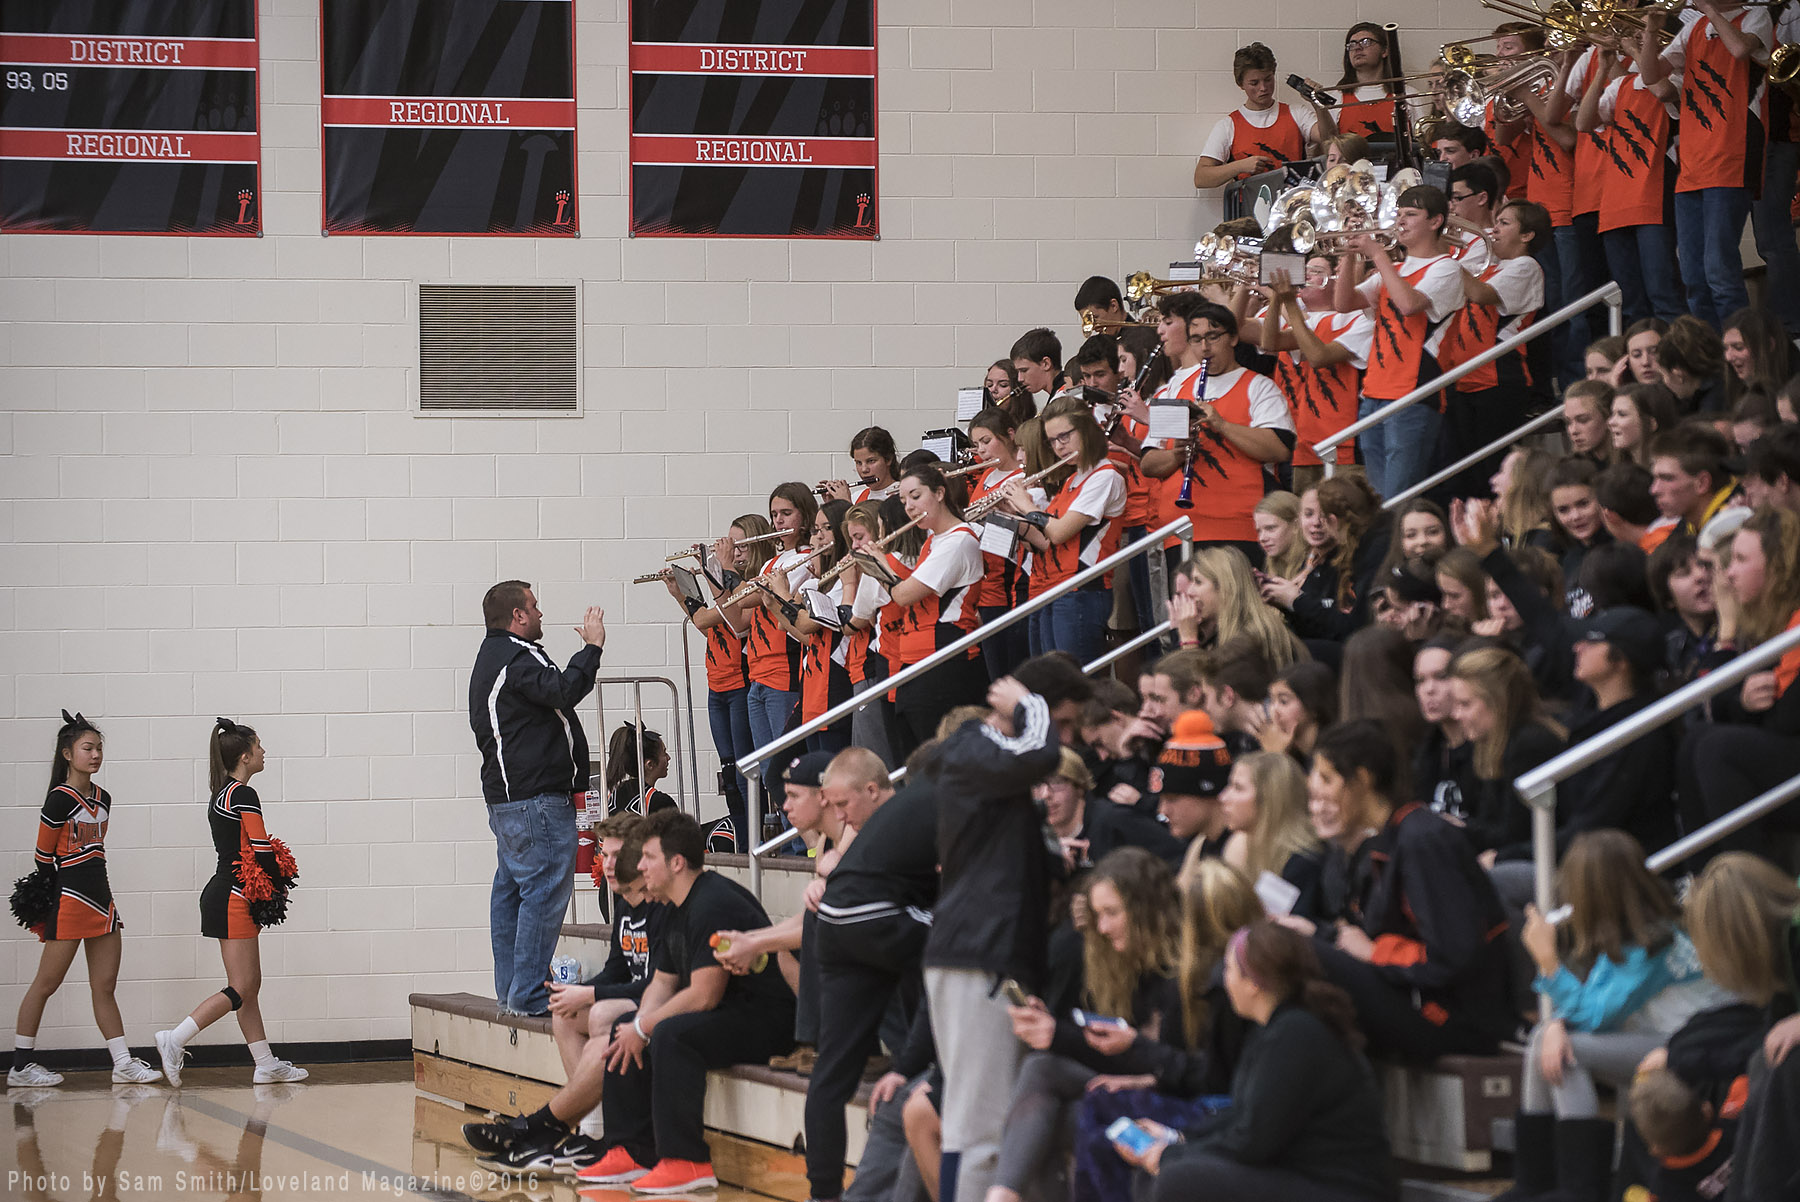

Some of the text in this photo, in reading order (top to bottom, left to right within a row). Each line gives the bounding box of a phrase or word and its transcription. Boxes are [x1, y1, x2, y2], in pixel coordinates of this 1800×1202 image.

[70, 40, 184, 64] DISTRICT
[700, 49, 807, 71] DISTRICT
[6, 71, 68, 92] 93, 05
[389, 102, 510, 124] REGIONAL
[66, 134, 191, 158] REGIONAL
[696, 140, 812, 163] REGIONAL
